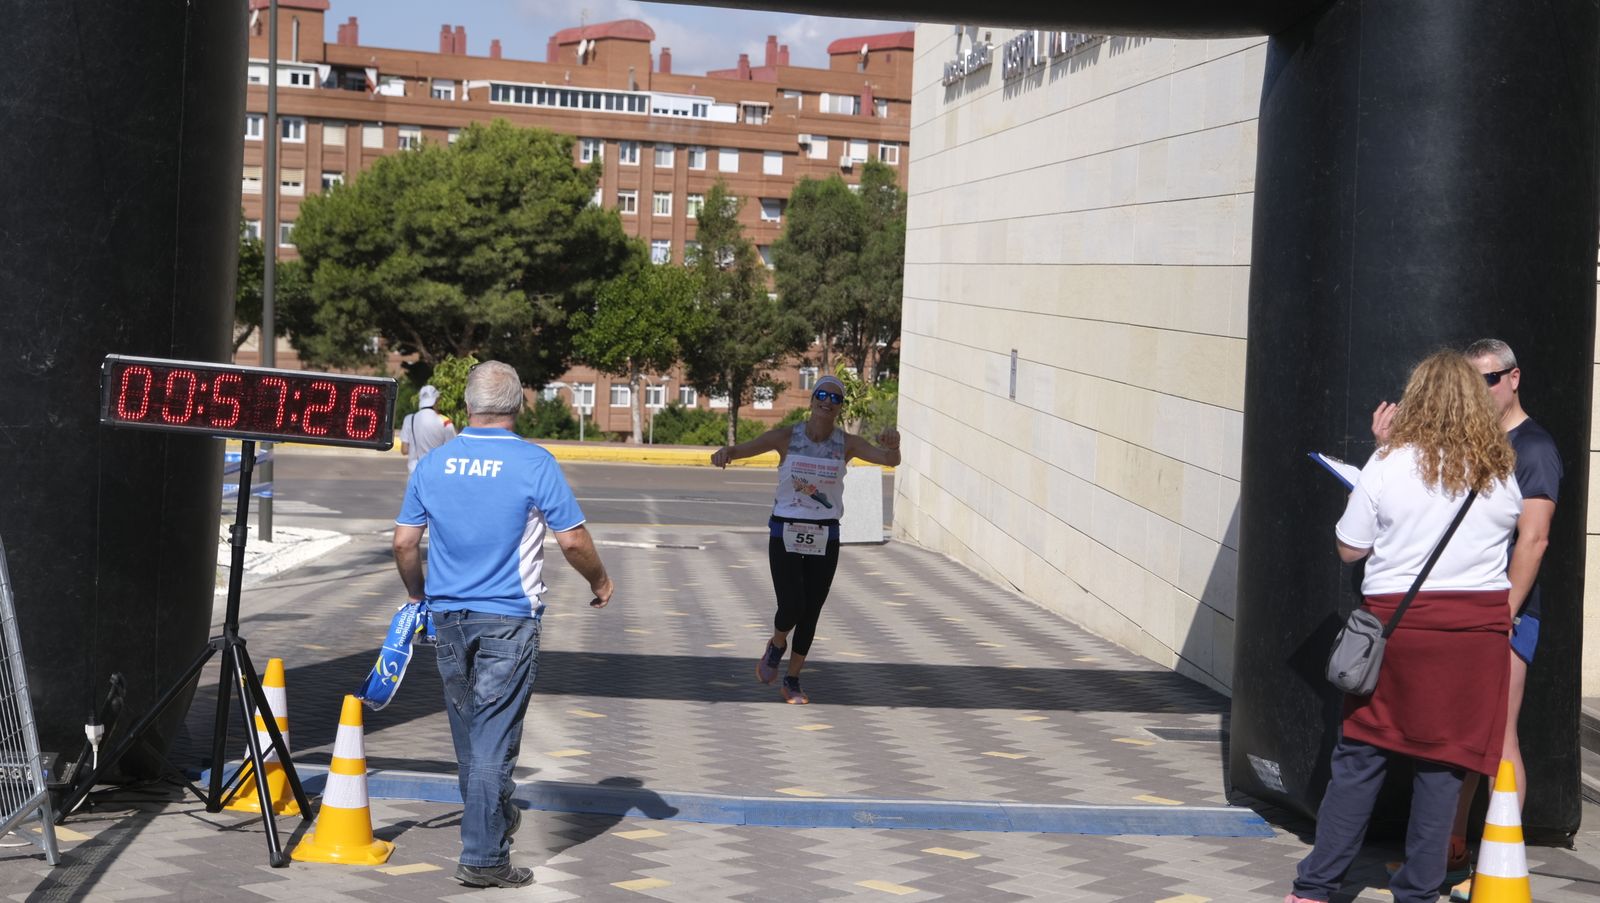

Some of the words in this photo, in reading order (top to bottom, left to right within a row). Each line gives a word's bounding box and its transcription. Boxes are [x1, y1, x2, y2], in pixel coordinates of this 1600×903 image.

[118, 366, 379, 438] 00:57:26
[444, 457, 504, 478] STAFF
[795, 533, 815, 545] 55
